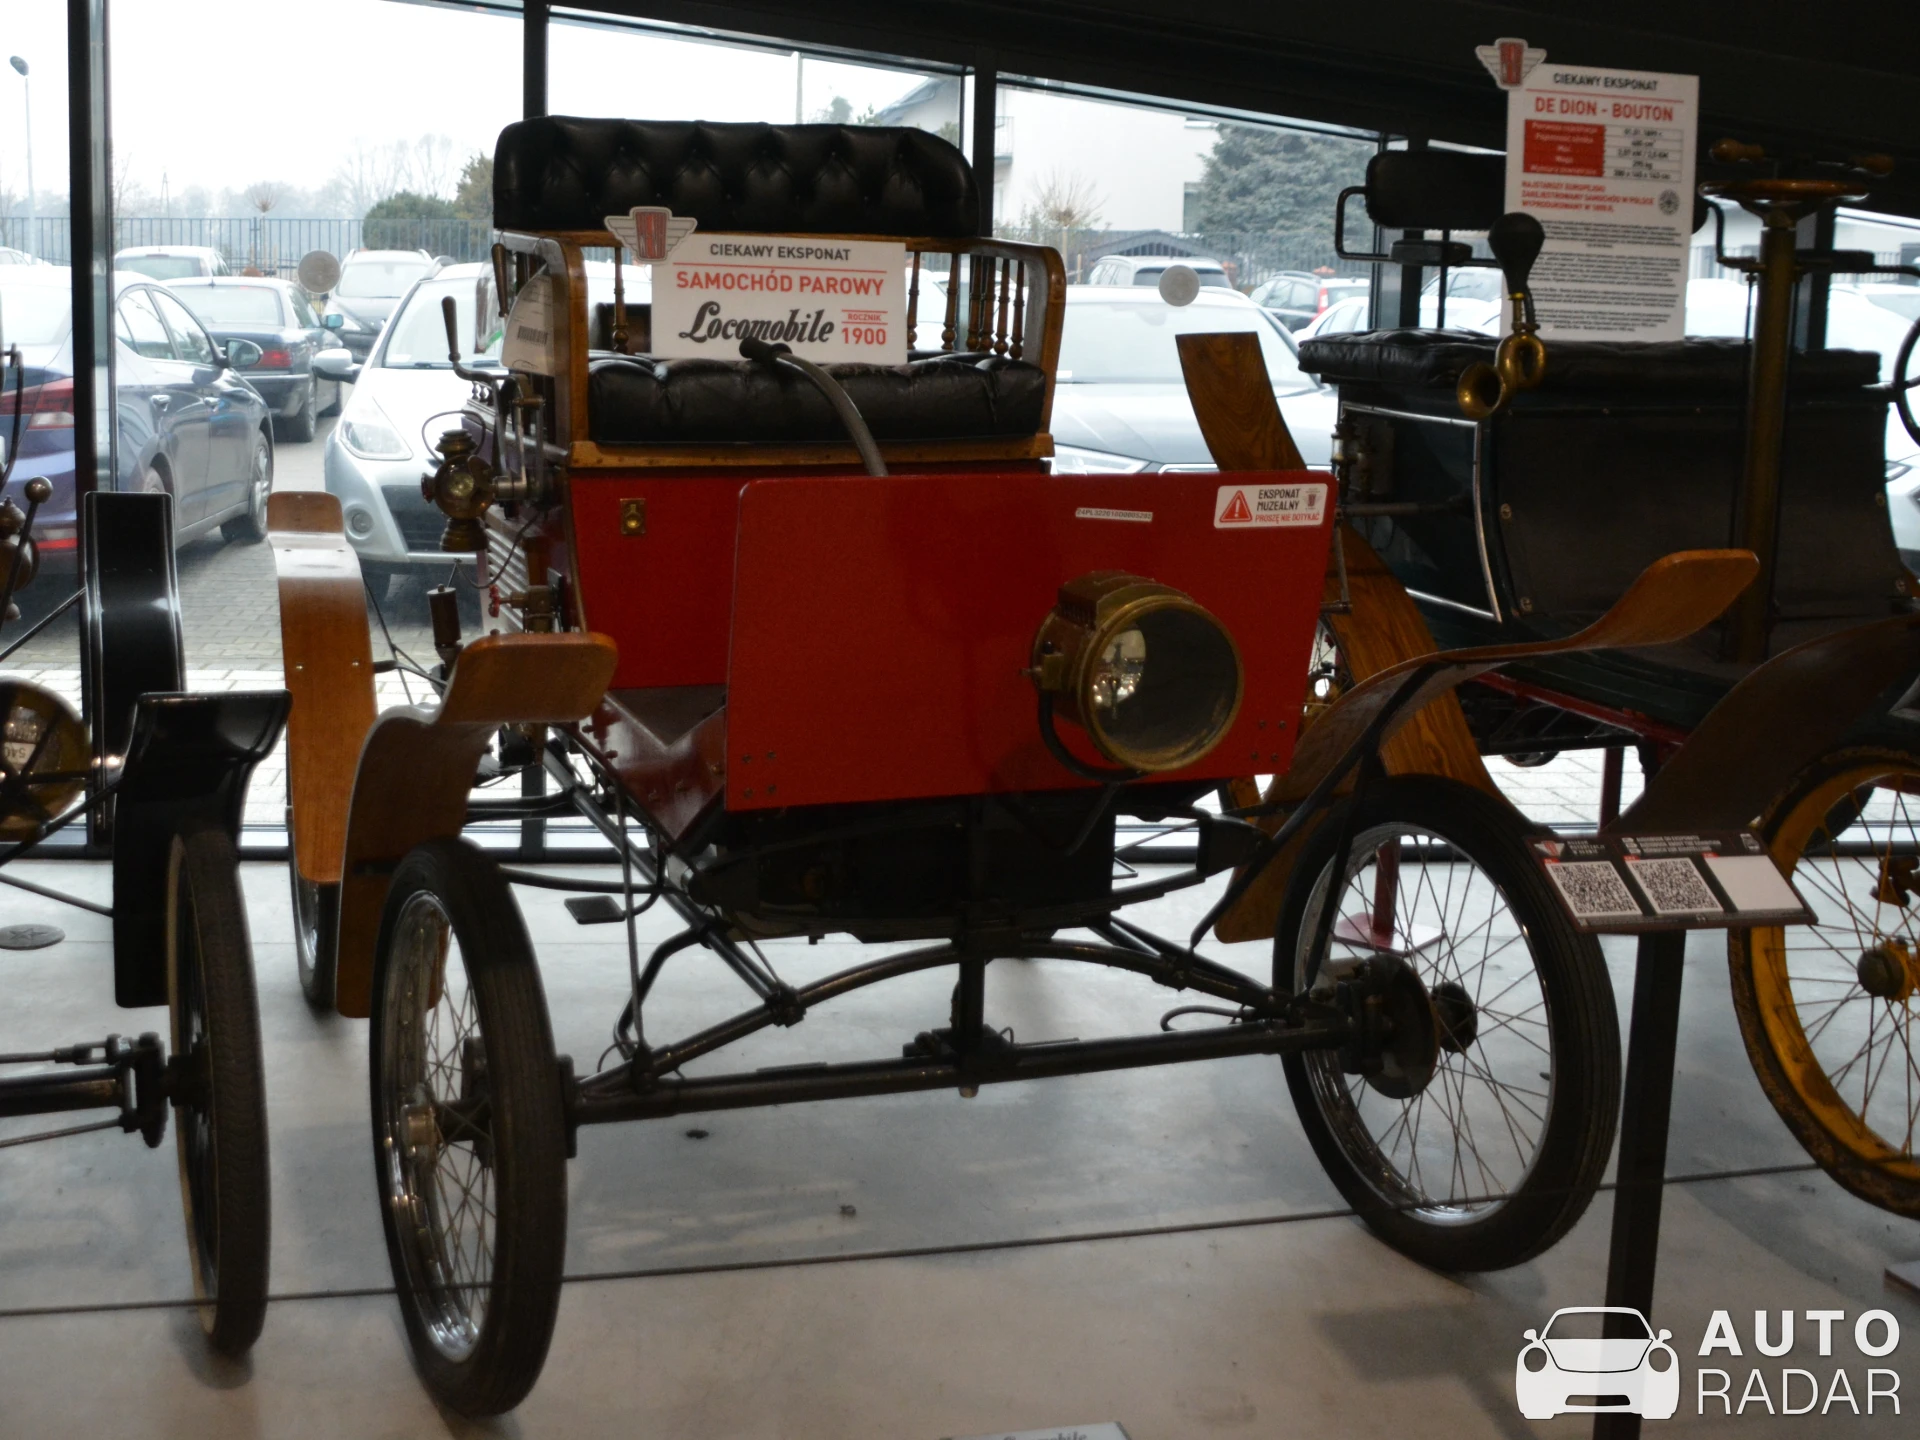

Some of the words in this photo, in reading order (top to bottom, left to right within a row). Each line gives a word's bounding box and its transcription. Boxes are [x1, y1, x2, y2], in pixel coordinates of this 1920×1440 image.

[1553, 72, 1600, 88] CIEKAWY
[1604, 76, 1658, 91] EKSPONAT
[1535, 96, 1554, 113] DE
[1560, 98, 1597, 116] DION
[1612, 101, 1674, 122] BOUTON
[709, 243, 773, 258] CIEKAWY
[777, 246, 851, 261] EKSPONAT
[676, 269, 793, 293] SAMOCHÓD
[799, 274, 884, 297] PAROWY
[678, 300, 835, 344] Locomobile
[847, 313, 882, 322] ROCZNIK
[841, 327, 886, 345] 1900
[1258, 488, 1301, 500] EKSPONAT
[1256, 500, 1300, 511] MUZEALNY
[1255, 513, 1280, 524] PROSZĘ
[1281, 513, 1291, 522] NIE
[1292, 511, 1320, 522] DOTYKAĆ
